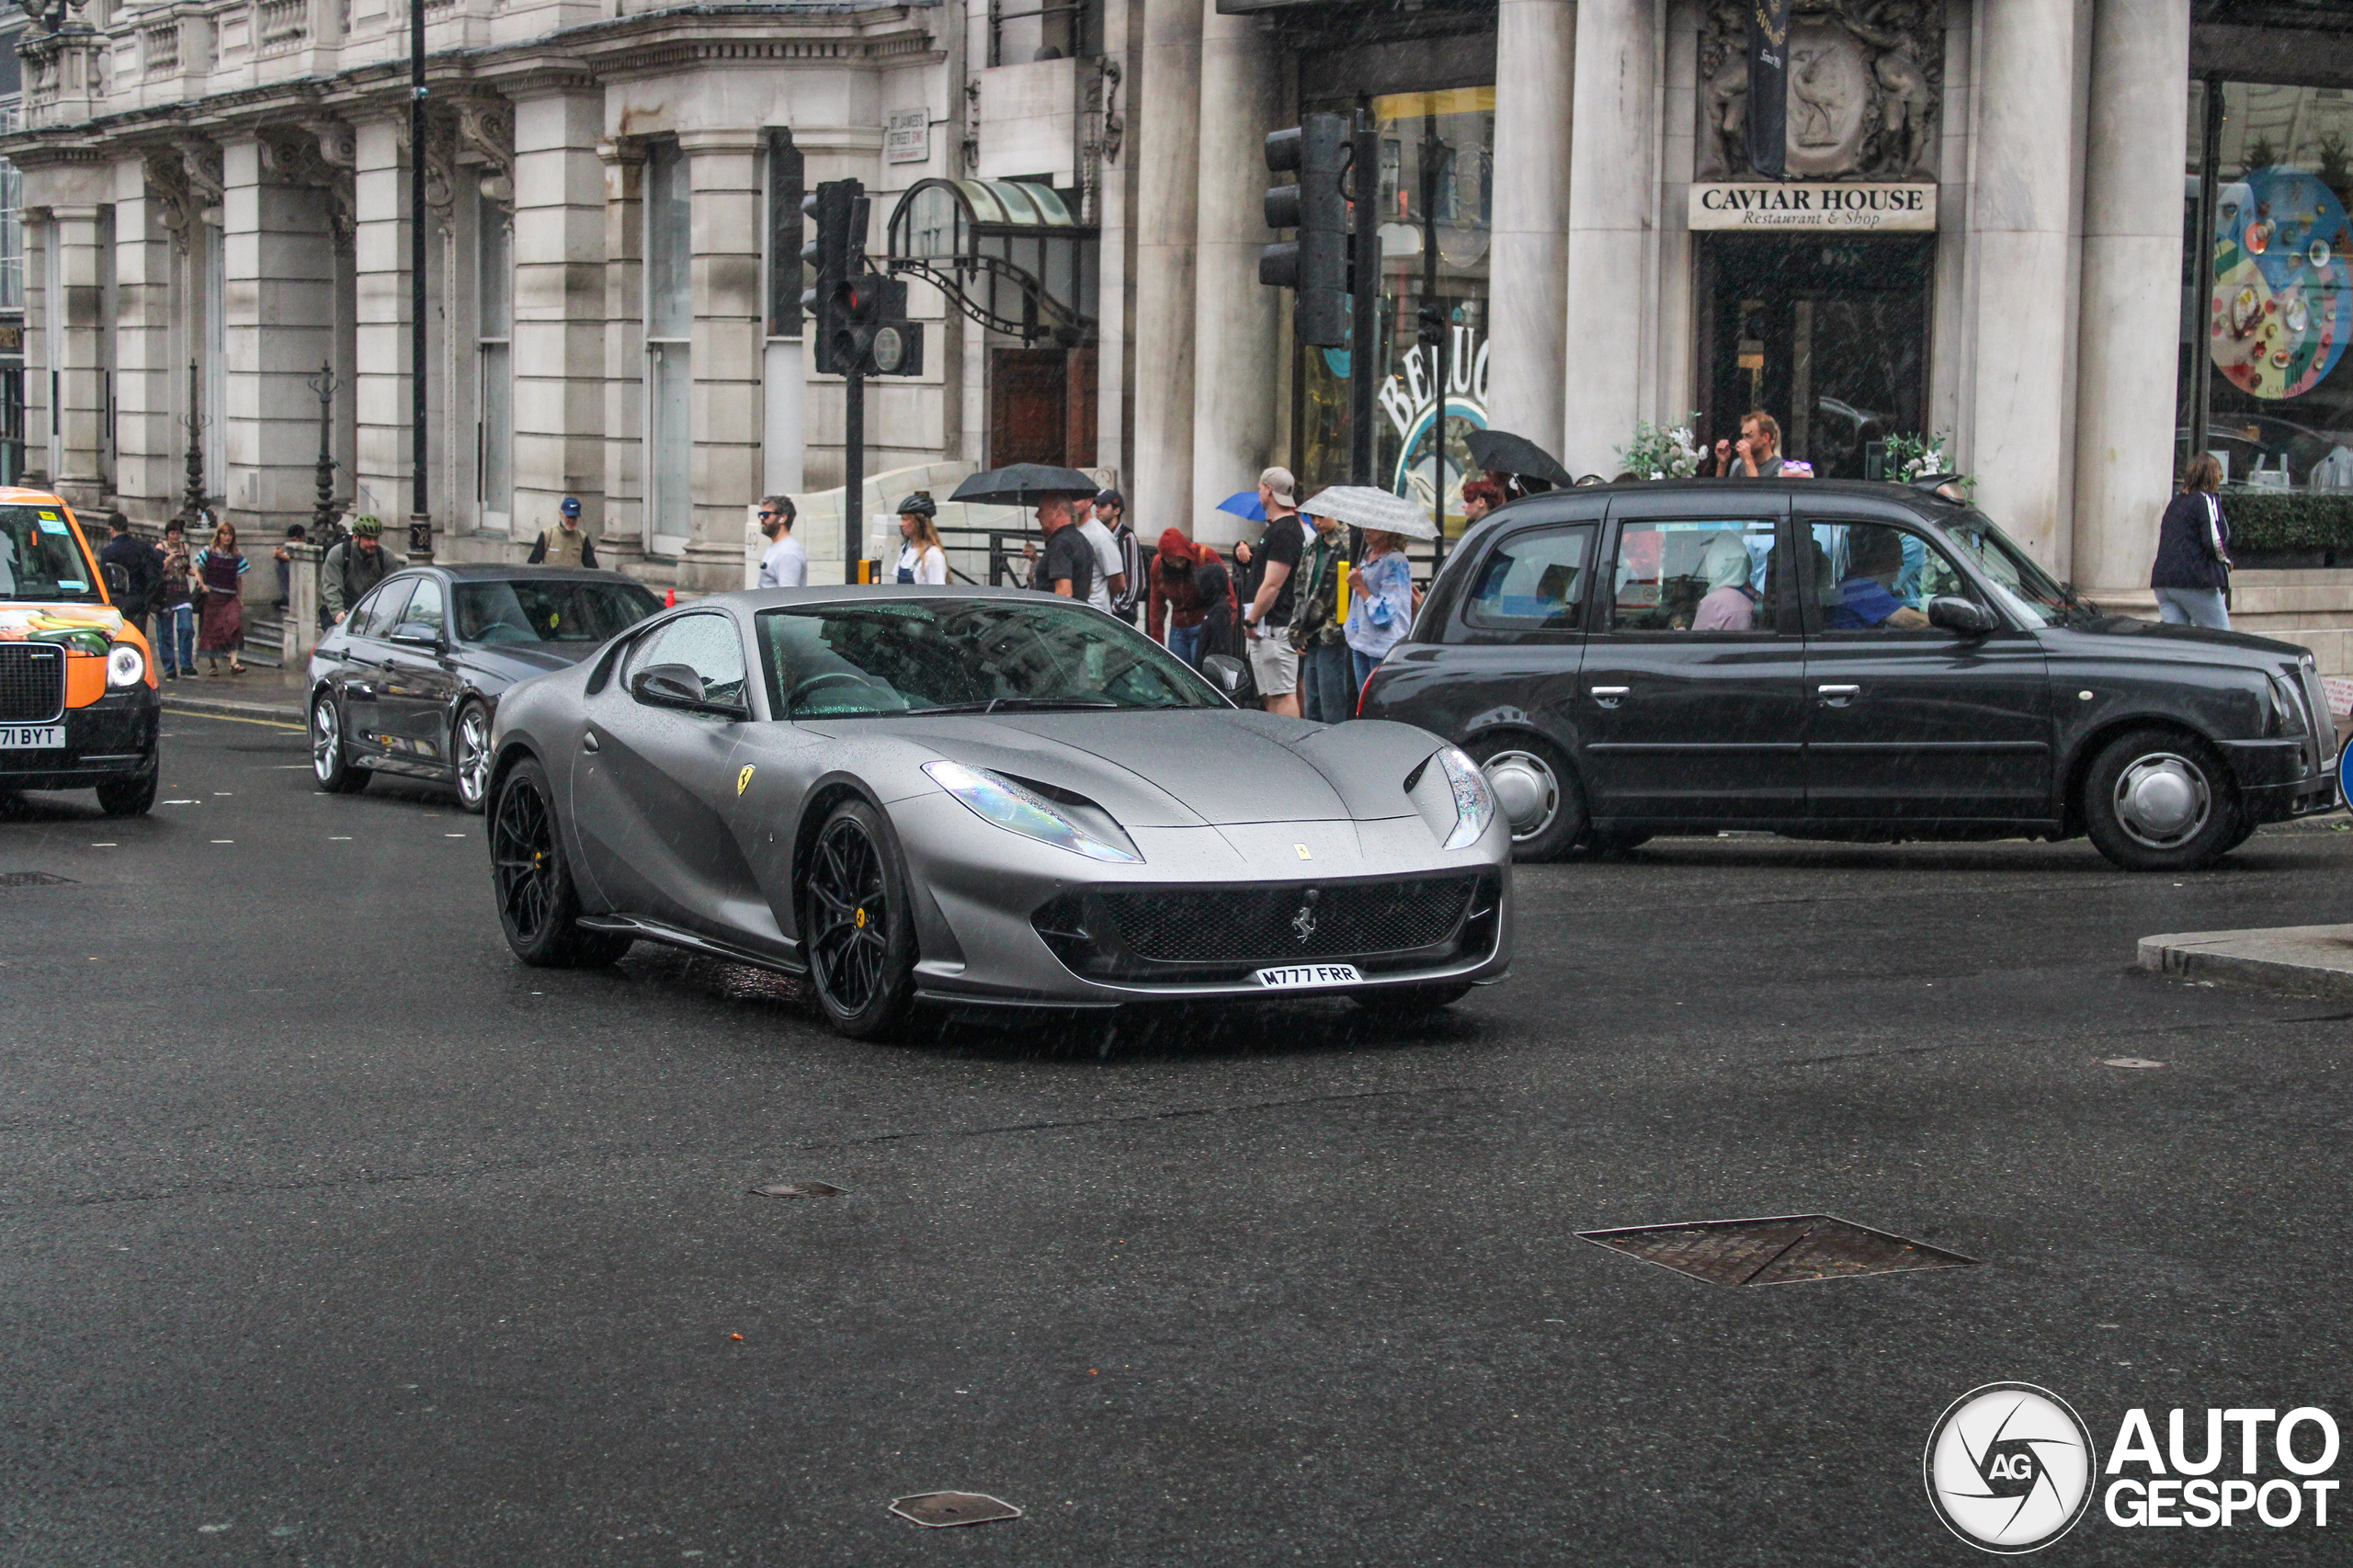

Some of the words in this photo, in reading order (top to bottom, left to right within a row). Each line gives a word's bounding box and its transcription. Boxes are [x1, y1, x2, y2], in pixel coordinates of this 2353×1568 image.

[890, 131, 910, 145] STREET
[1702, 189, 1811, 210] CAVIAR
[1822, 189, 1924, 211] HOUSE
[1744, 210, 1822, 225] Restaurant
[1827, 211, 1839, 225] &
[1845, 210, 1881, 229] Shop
[745, 532, 758, 551] 49
[0, 729, 16, 745] 71
[21, 728, 55, 744] BYT
[1262, 968, 1312, 984] M777
[1316, 967, 1356, 981] FRR
